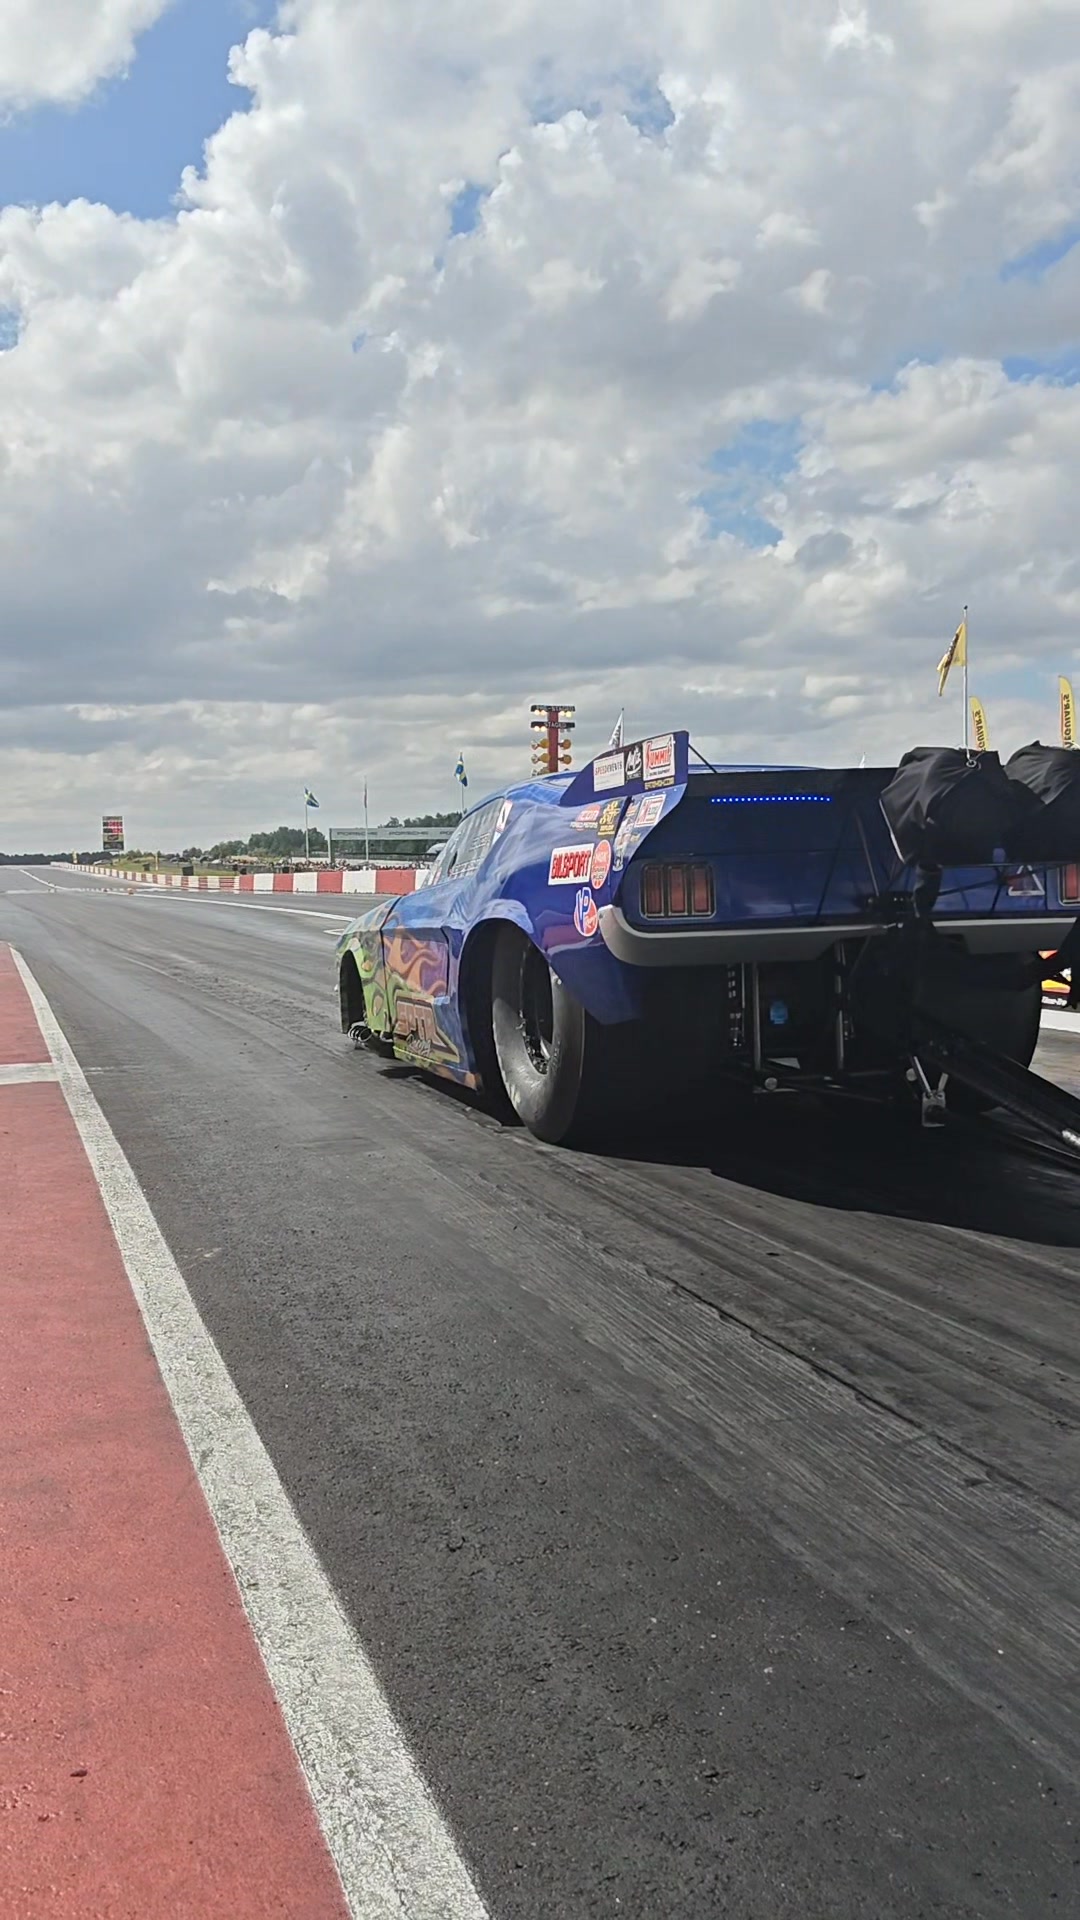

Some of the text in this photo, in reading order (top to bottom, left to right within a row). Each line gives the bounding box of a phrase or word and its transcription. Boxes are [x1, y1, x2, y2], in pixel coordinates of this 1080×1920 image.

[646, 736, 672, 769] SUMMIT
[551, 849, 591, 879] BILSPORT
[576, 887, 592, 933] VP
